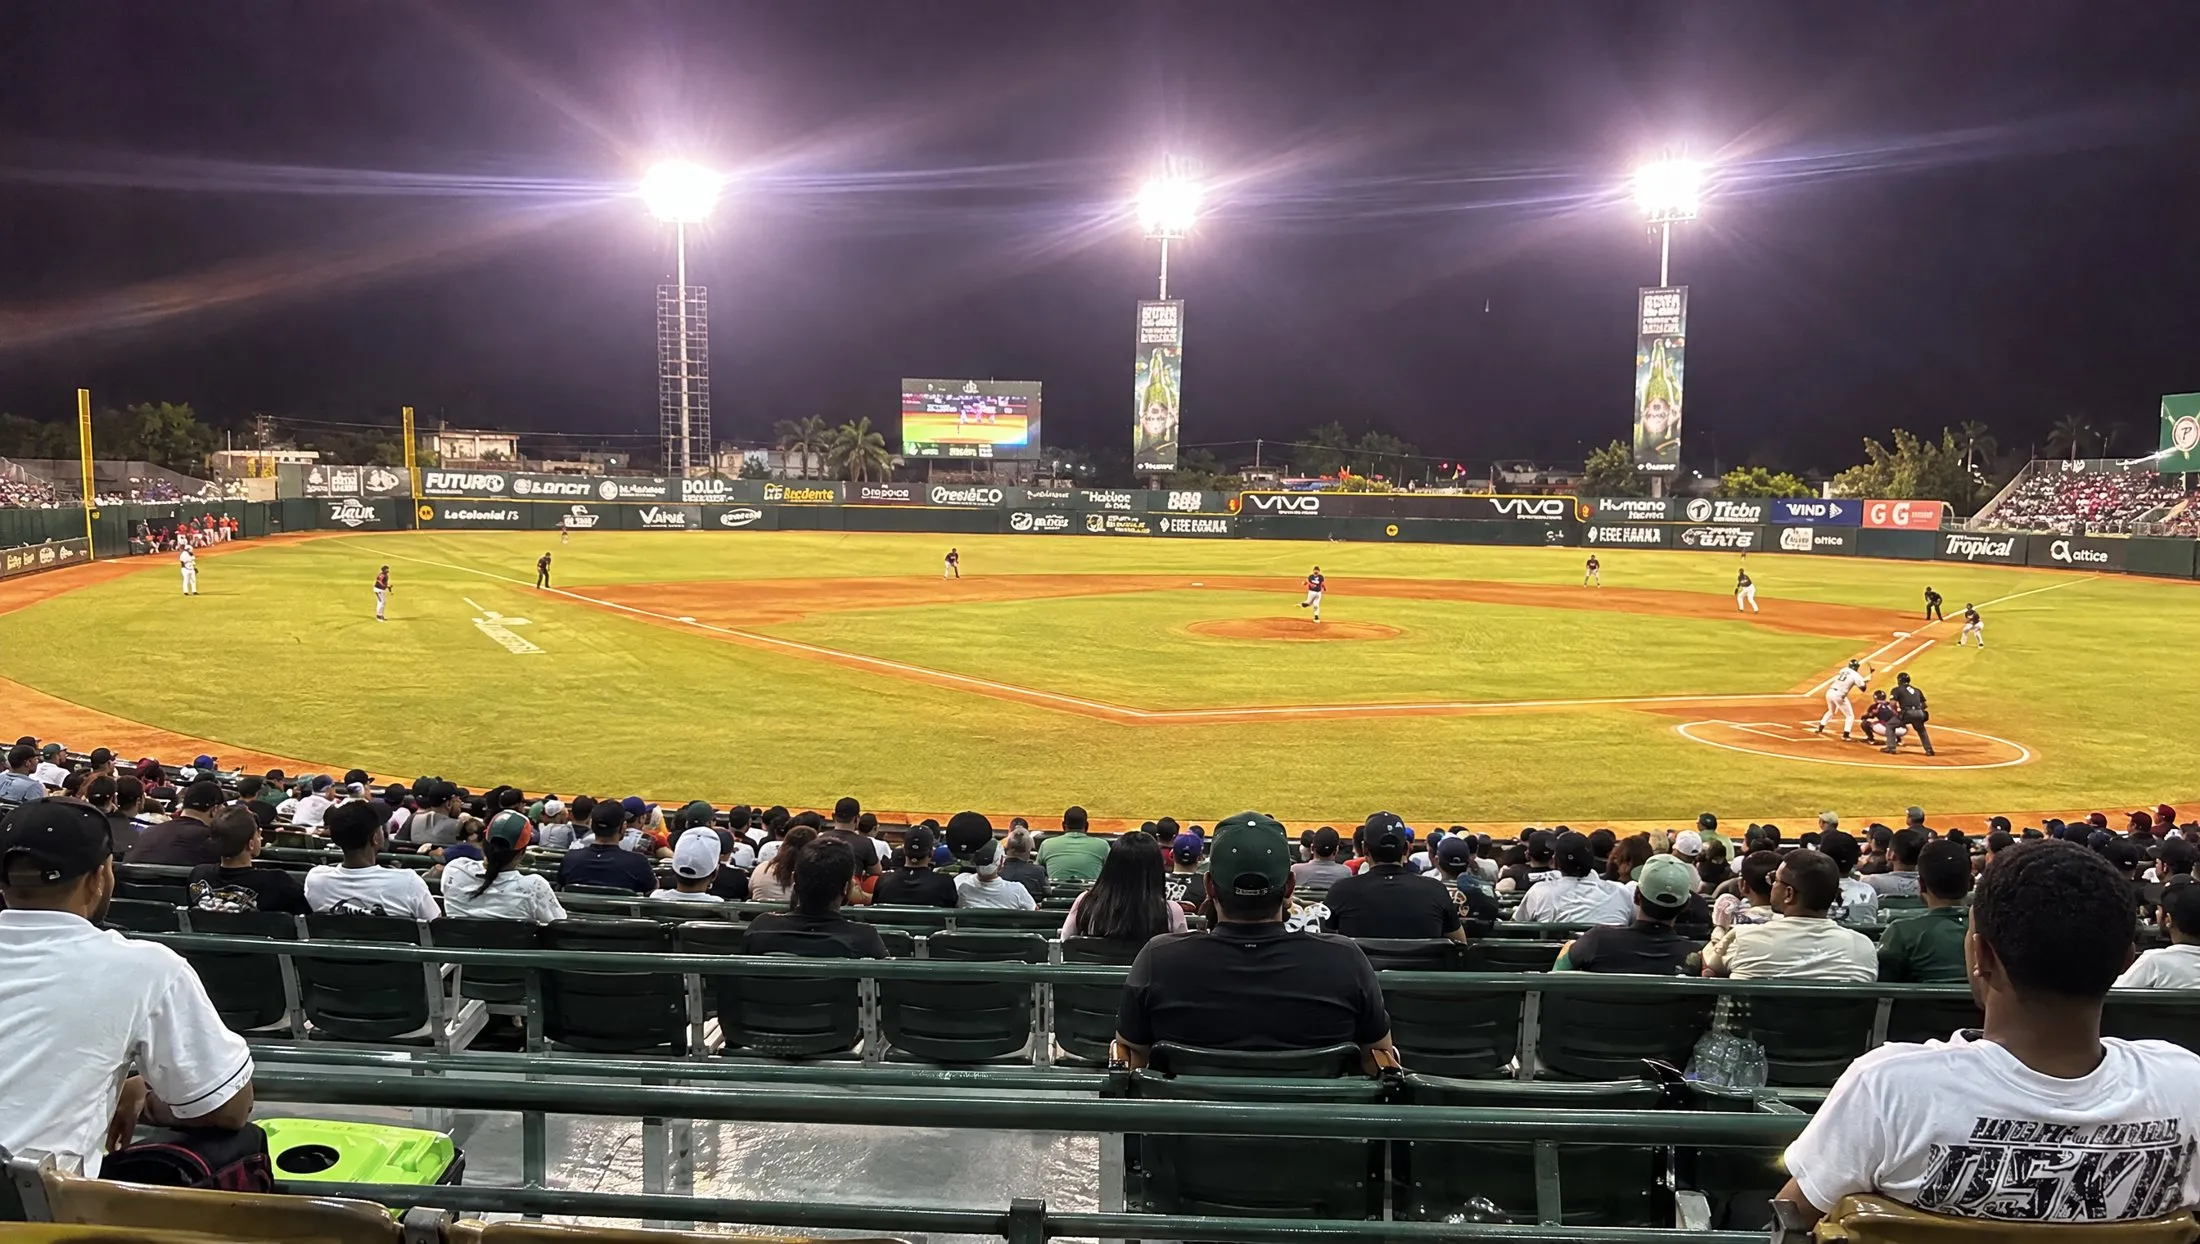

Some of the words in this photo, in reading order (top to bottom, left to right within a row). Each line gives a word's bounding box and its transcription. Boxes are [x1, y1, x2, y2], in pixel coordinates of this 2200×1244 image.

[1600, 498, 1666, 511] Humano
[1786, 504, 1826, 516] WIND
[1946, 534, 2015, 560] Tropical
[2072, 549, 2108, 563] altice
